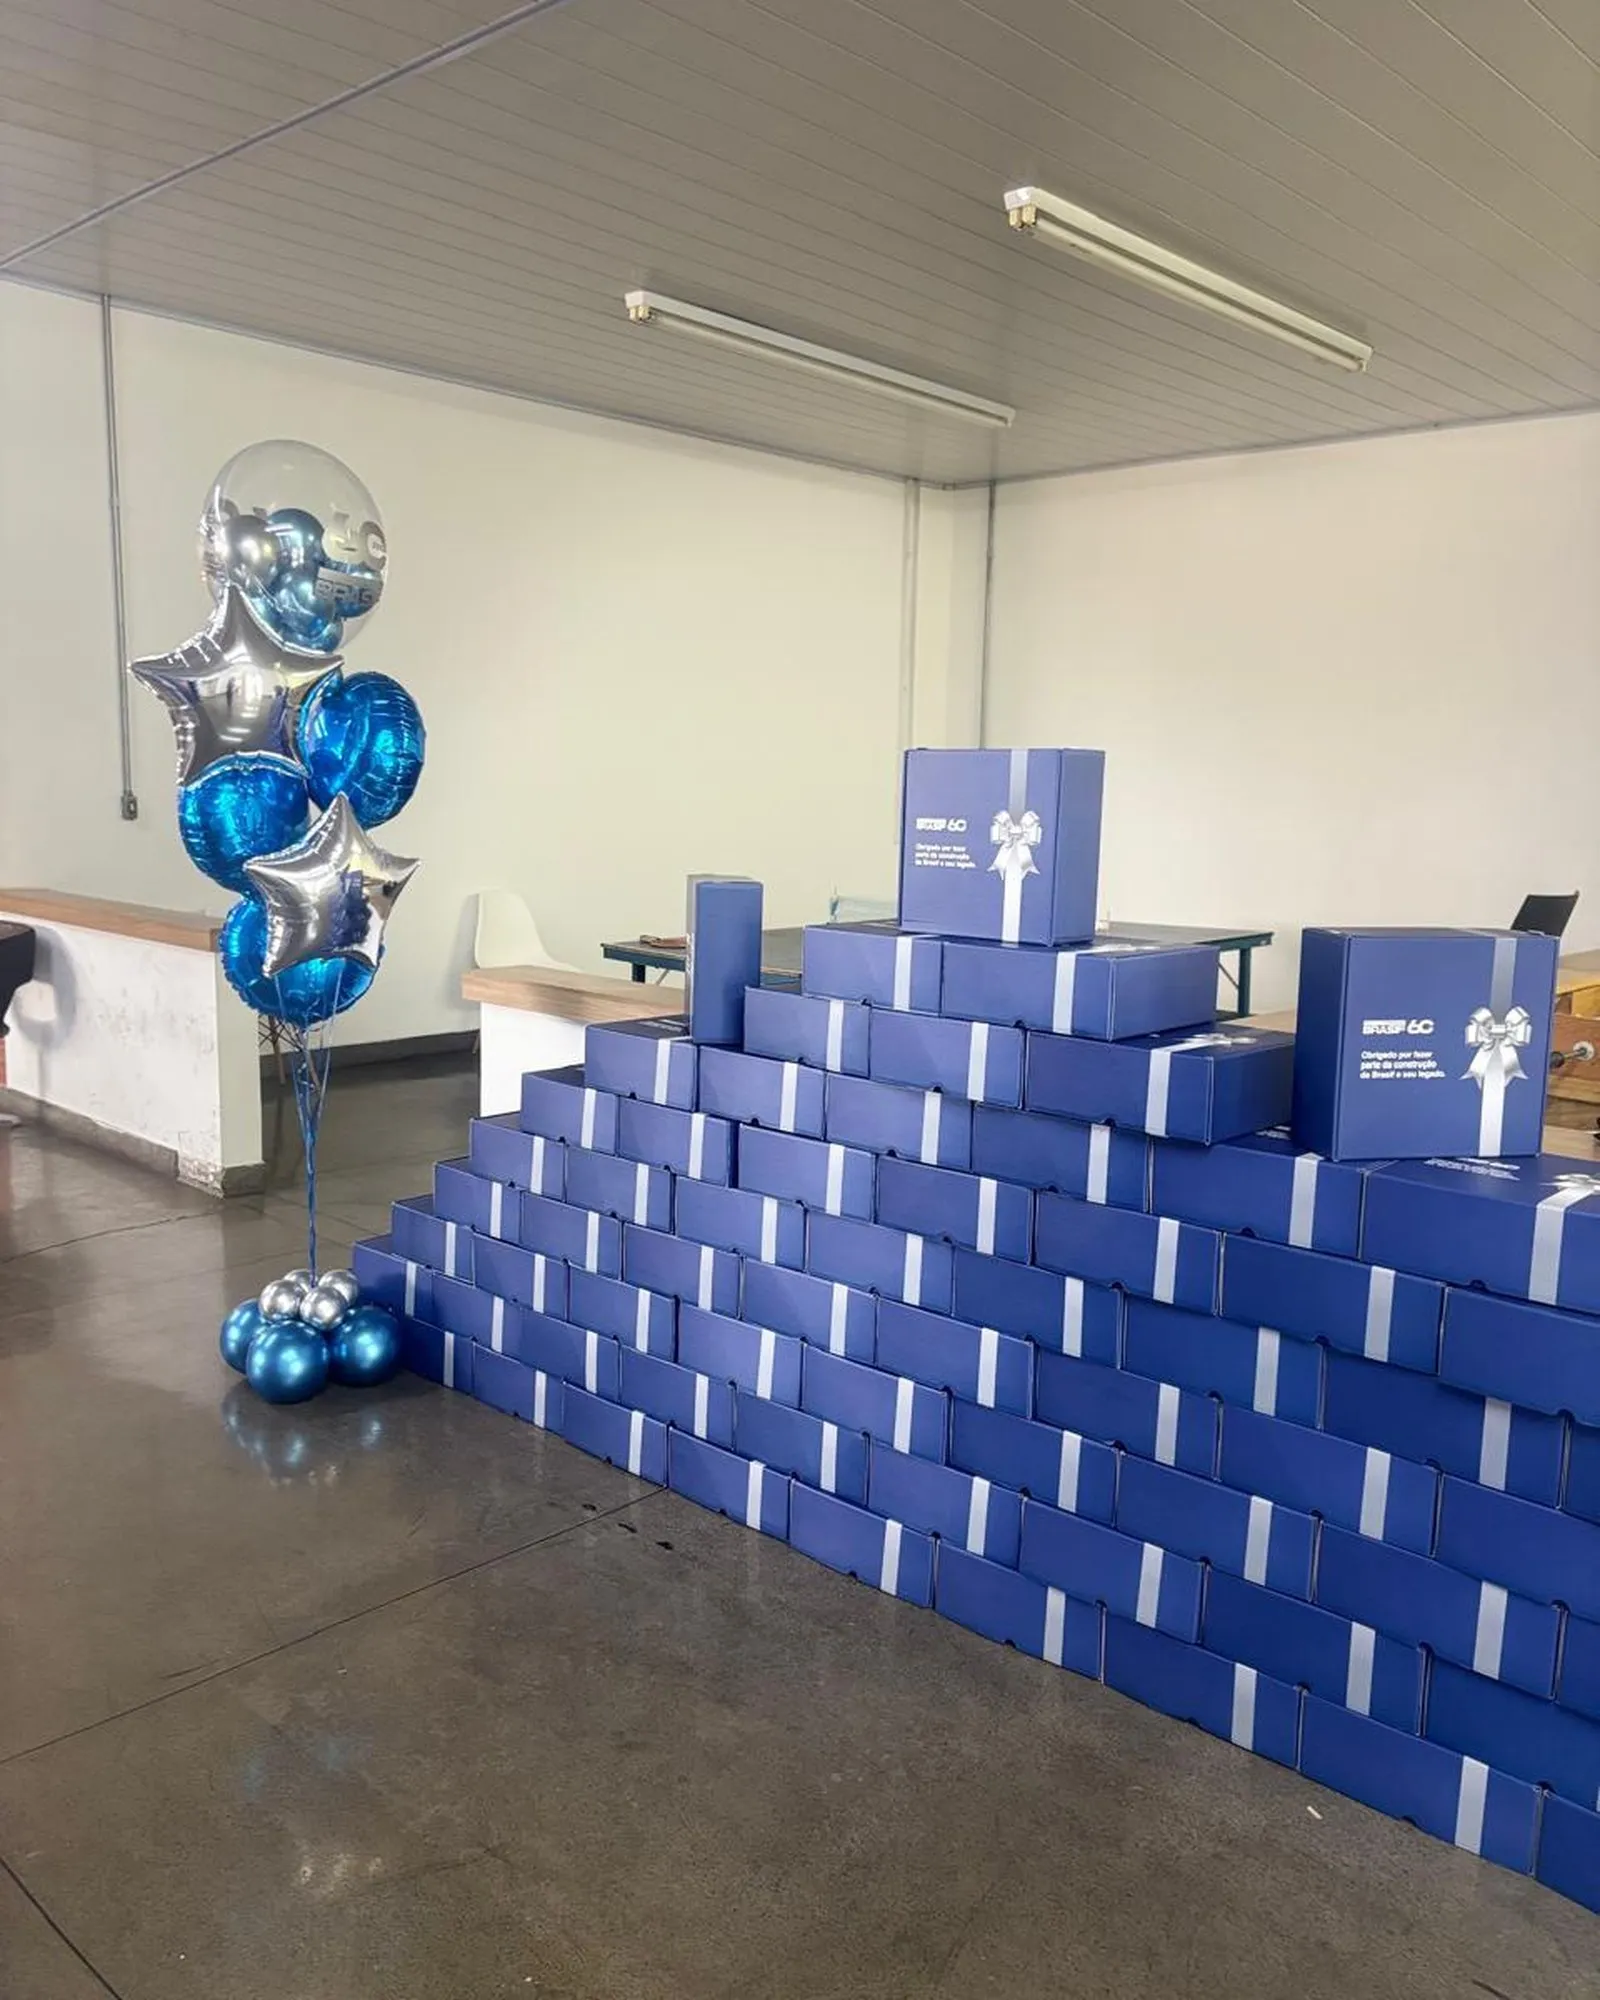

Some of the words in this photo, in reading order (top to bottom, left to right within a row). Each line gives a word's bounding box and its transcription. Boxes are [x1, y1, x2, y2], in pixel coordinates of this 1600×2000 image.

[1361, 1050, 1398, 1060] Obrigado
[1398, 1052, 1412, 1060] por
[1413, 1050, 1433, 1059] fazer
[1360, 1061, 1380, 1071] parte
[1393, 1060, 1438, 1070] construção
[1402, 1071, 1417, 1079] seu
